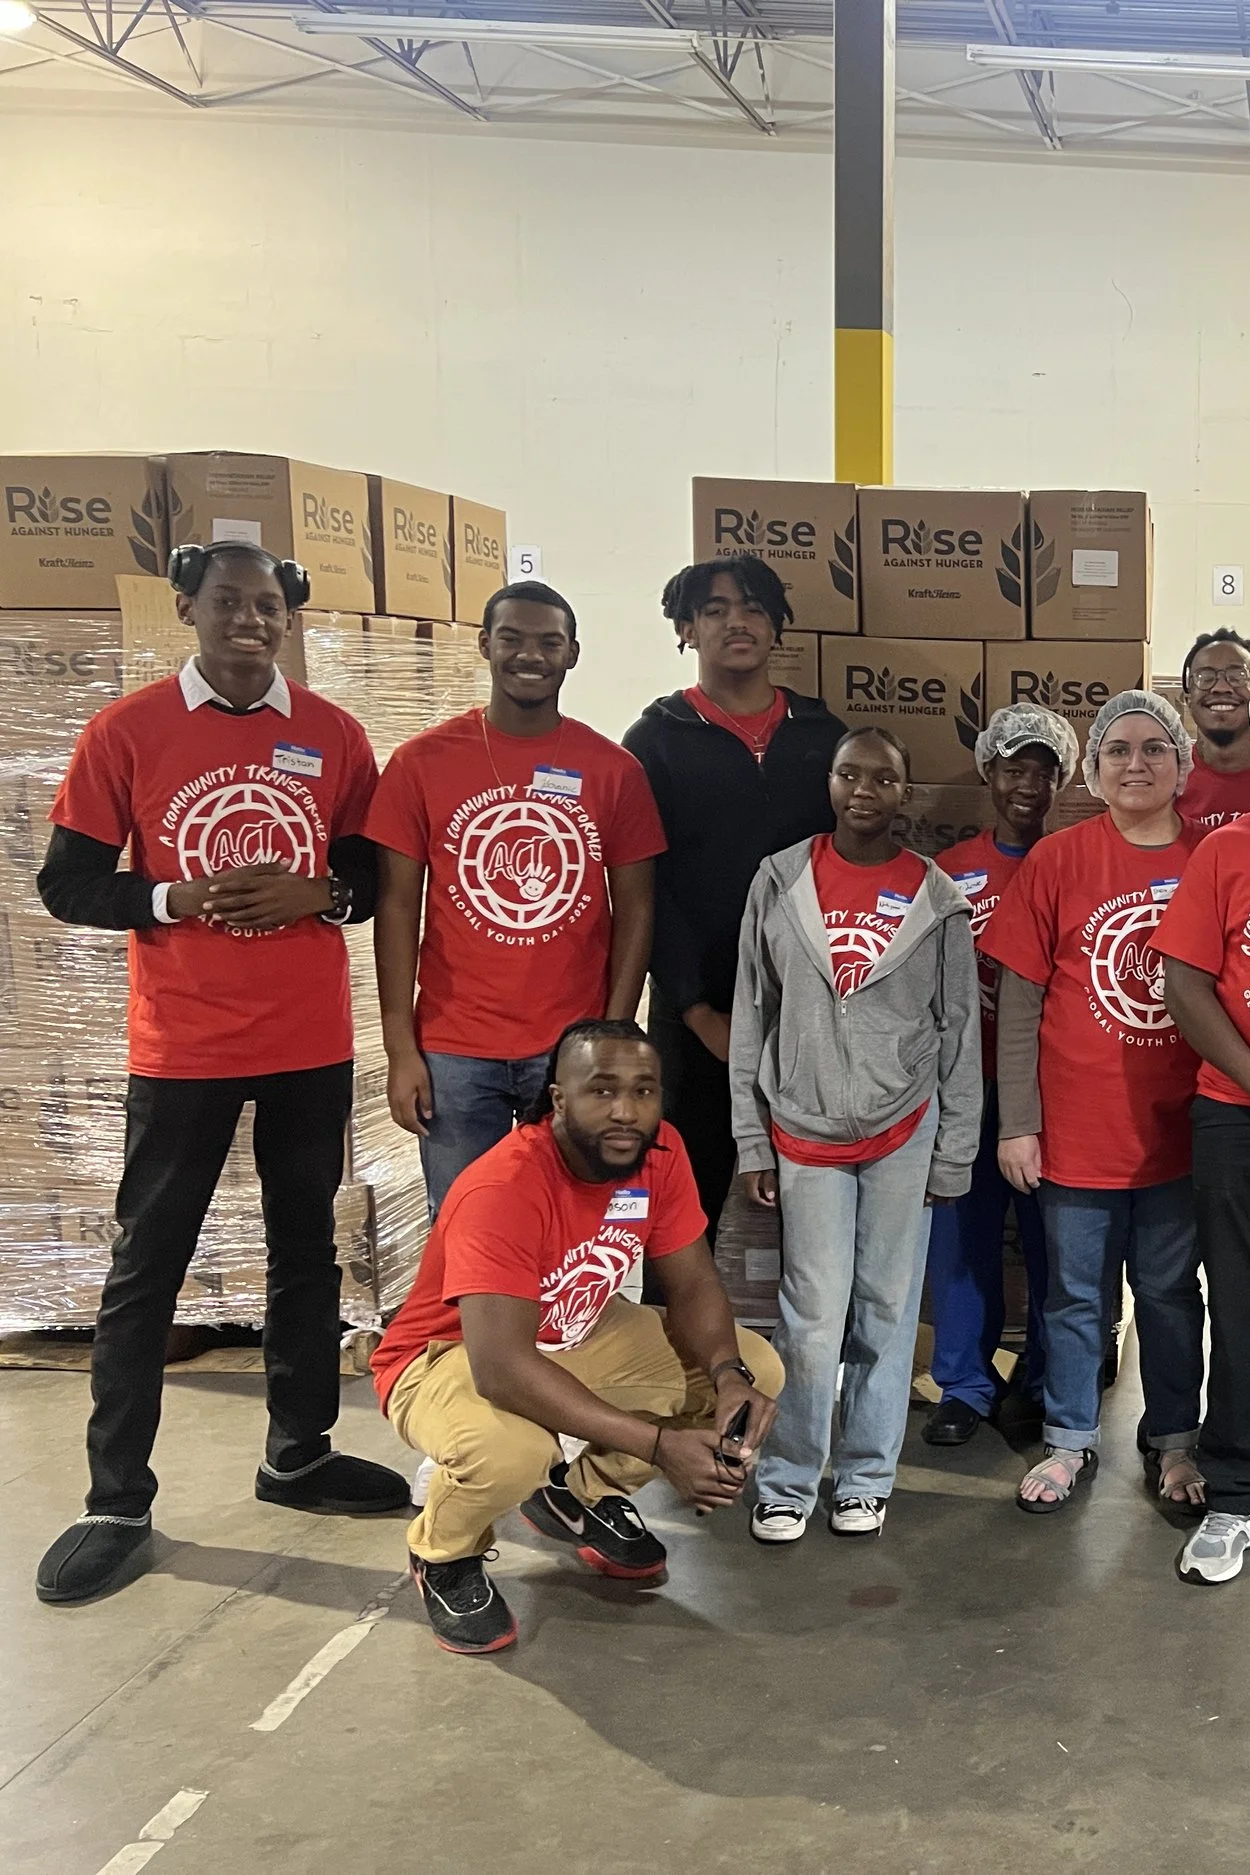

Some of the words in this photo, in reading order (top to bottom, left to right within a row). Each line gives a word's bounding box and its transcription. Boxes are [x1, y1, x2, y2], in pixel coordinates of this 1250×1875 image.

[5, 486, 112, 524] Rise
[303, 492, 354, 535] Rise
[11, 527, 60, 537] AGAINST
[65, 527, 114, 537] HUNGER
[393, 507, 437, 547] Rise
[464, 523, 499, 560] Rise
[715, 508, 816, 547] Rise
[882, 519, 983, 556] Rise
[520, 554, 533, 574] 5
[715, 548, 764, 558] AGAINST
[768, 550, 816, 560] HUNGER
[883, 558, 932, 567] AGAINST
[936, 559, 983, 568] HUNGER
[1222, 574, 1235, 594] 8
[846, 665, 946, 703] Rise
[1011, 671, 1109, 706] Rise
[847, 704, 895, 714] AGAINST
[900, 705, 946, 716] HUNGER
[1063, 709, 1098, 718] HUNG
[162, 764, 237, 830] COMMUNITY
[244, 764, 327, 841] TRANSFORMED
[446, 784, 517, 840] COMMUNITY
[159, 836, 175, 848] A
[444, 843, 459, 855] A
[448, 885, 482, 931] GLOBAL
[486, 928, 535, 946] YOUTH
[542, 925, 564, 943] DAY
[569, 894, 592, 924] 2025
[1081, 889, 1148, 941] COMMUNITY
[1081, 946, 1093, 957] A
[1118, 1030, 1163, 1046] YOUTH
[608, 1201, 638, 1212] ason
